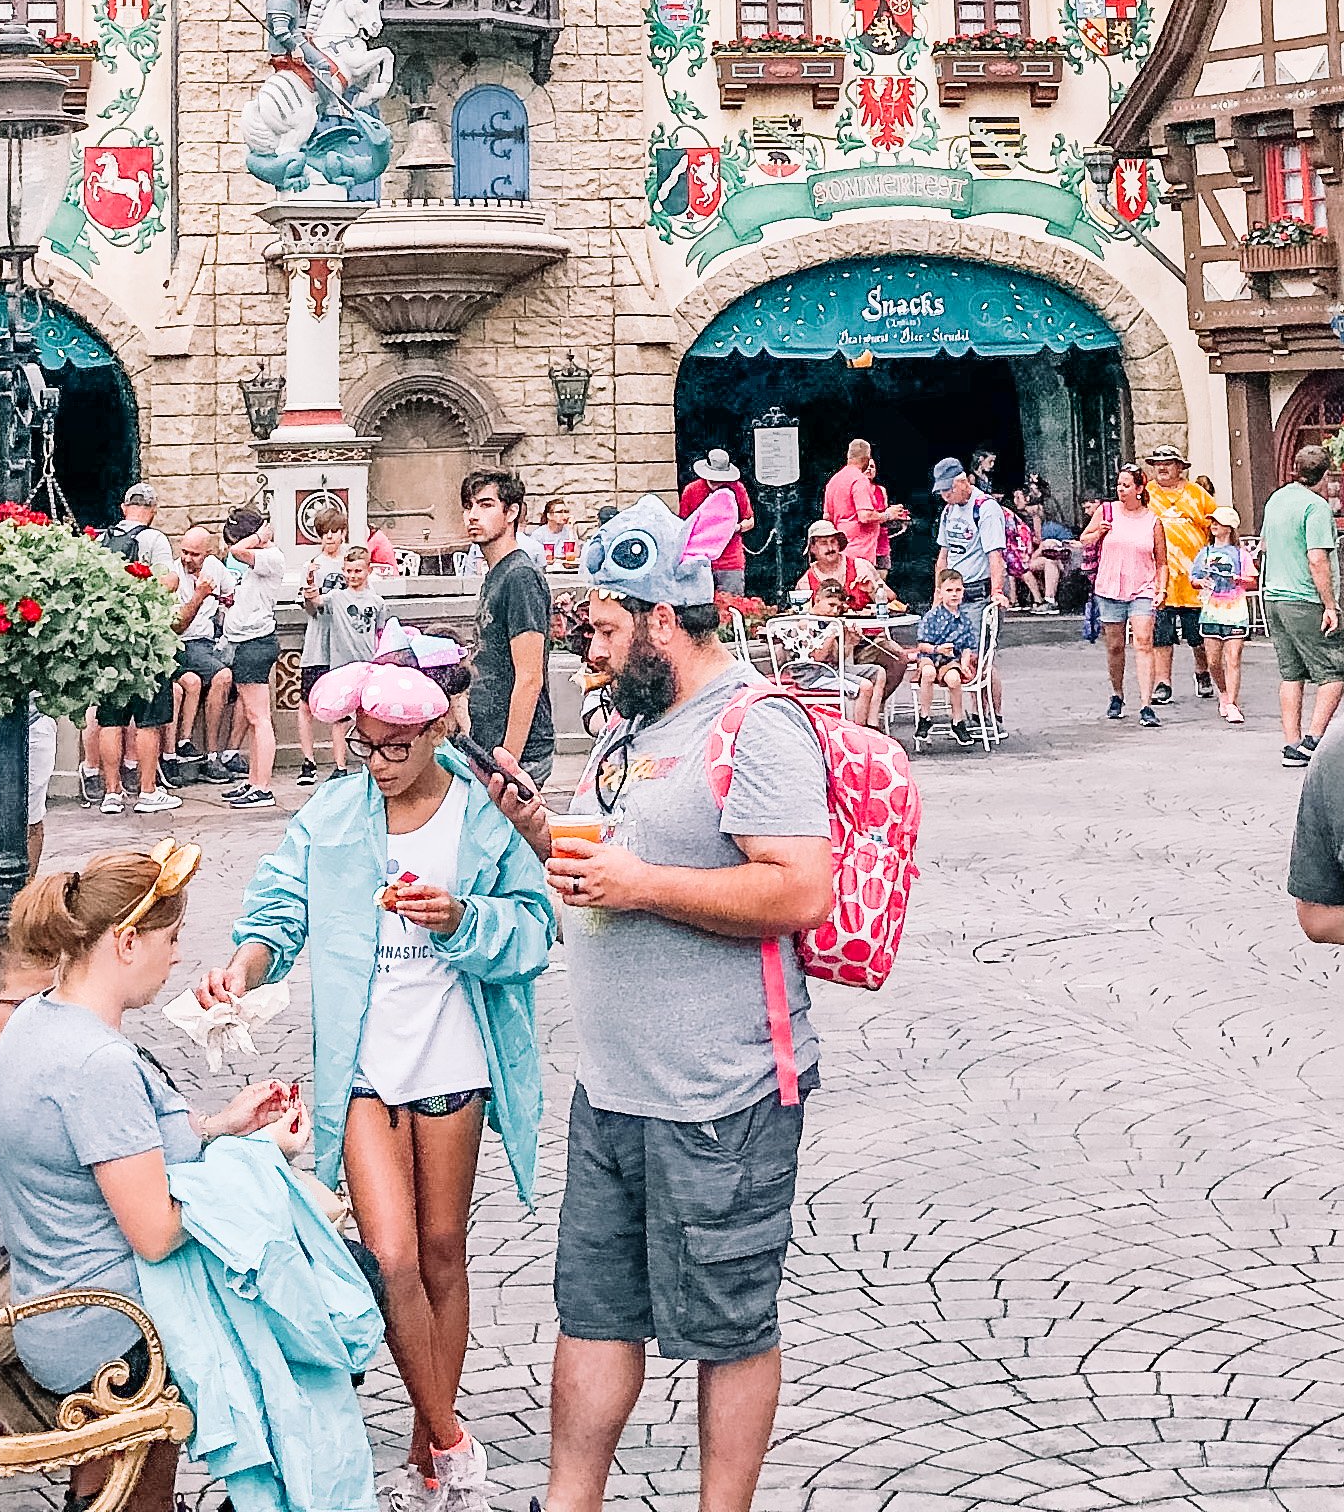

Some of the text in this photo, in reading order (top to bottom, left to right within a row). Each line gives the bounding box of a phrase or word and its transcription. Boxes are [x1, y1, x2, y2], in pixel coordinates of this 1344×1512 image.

[812, 172, 969, 208] SOMMERFEST
[861, 284, 945, 322] Snacks
[376, 945, 434, 959] MNASTIC
